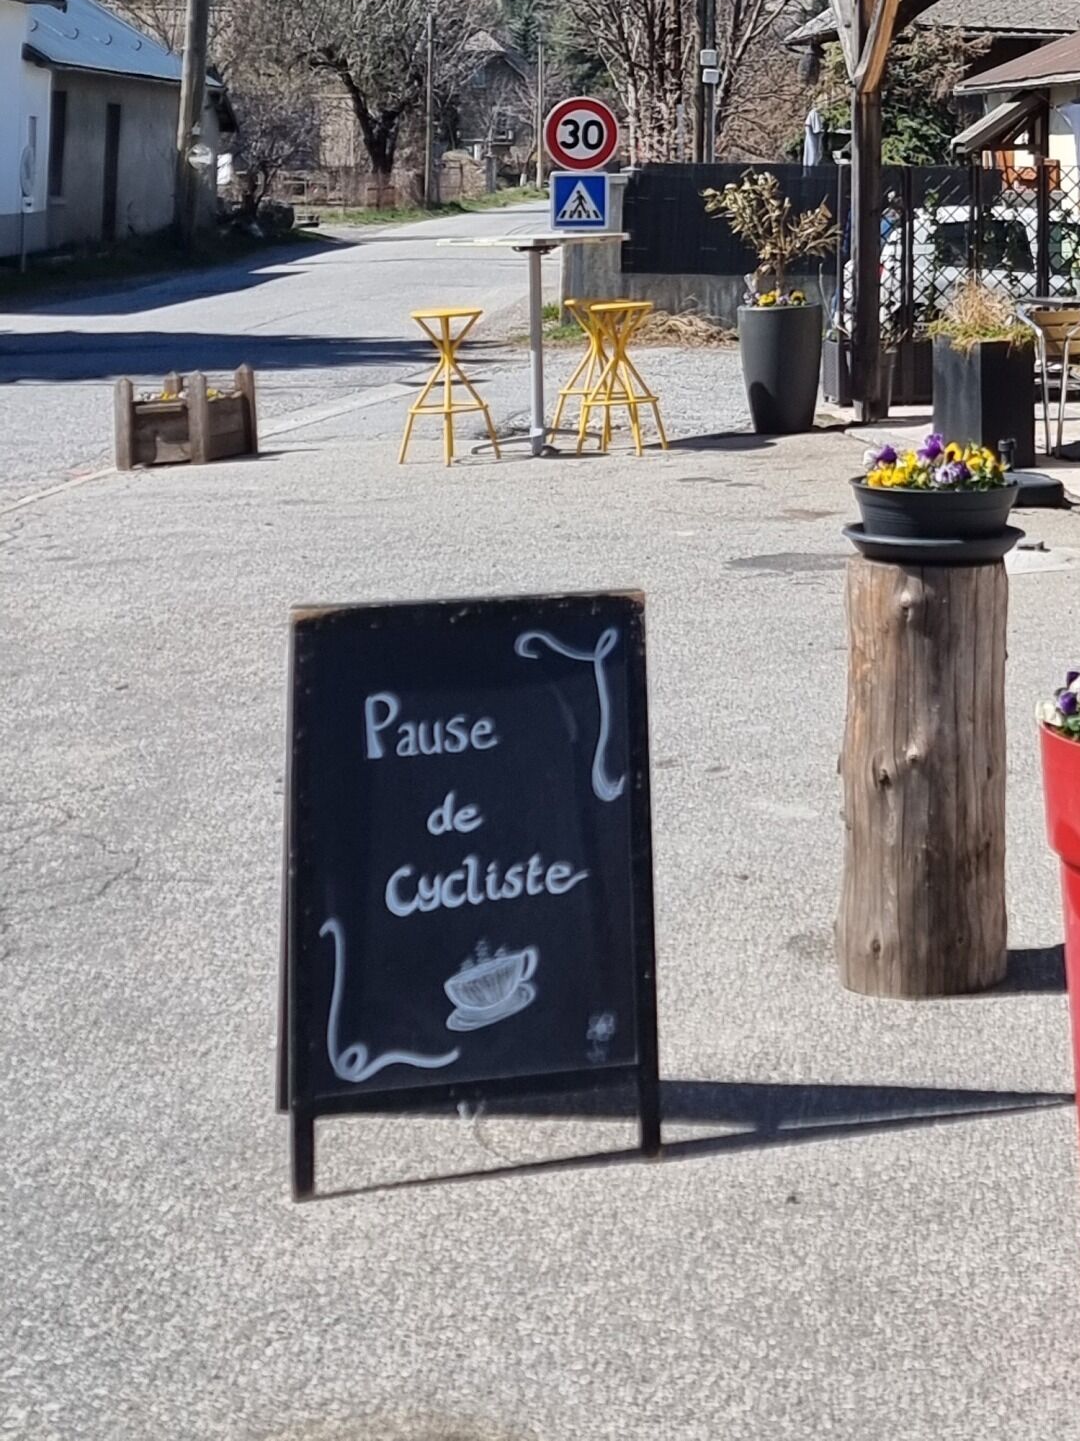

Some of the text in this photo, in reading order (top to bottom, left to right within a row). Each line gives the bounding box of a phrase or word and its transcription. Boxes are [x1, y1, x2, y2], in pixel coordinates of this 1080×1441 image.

[560, 119, 604, 150] 30
[364, 692, 499, 759] Pause
[426, 791, 484, 836] de
[385, 853, 590, 917] Cycliste
